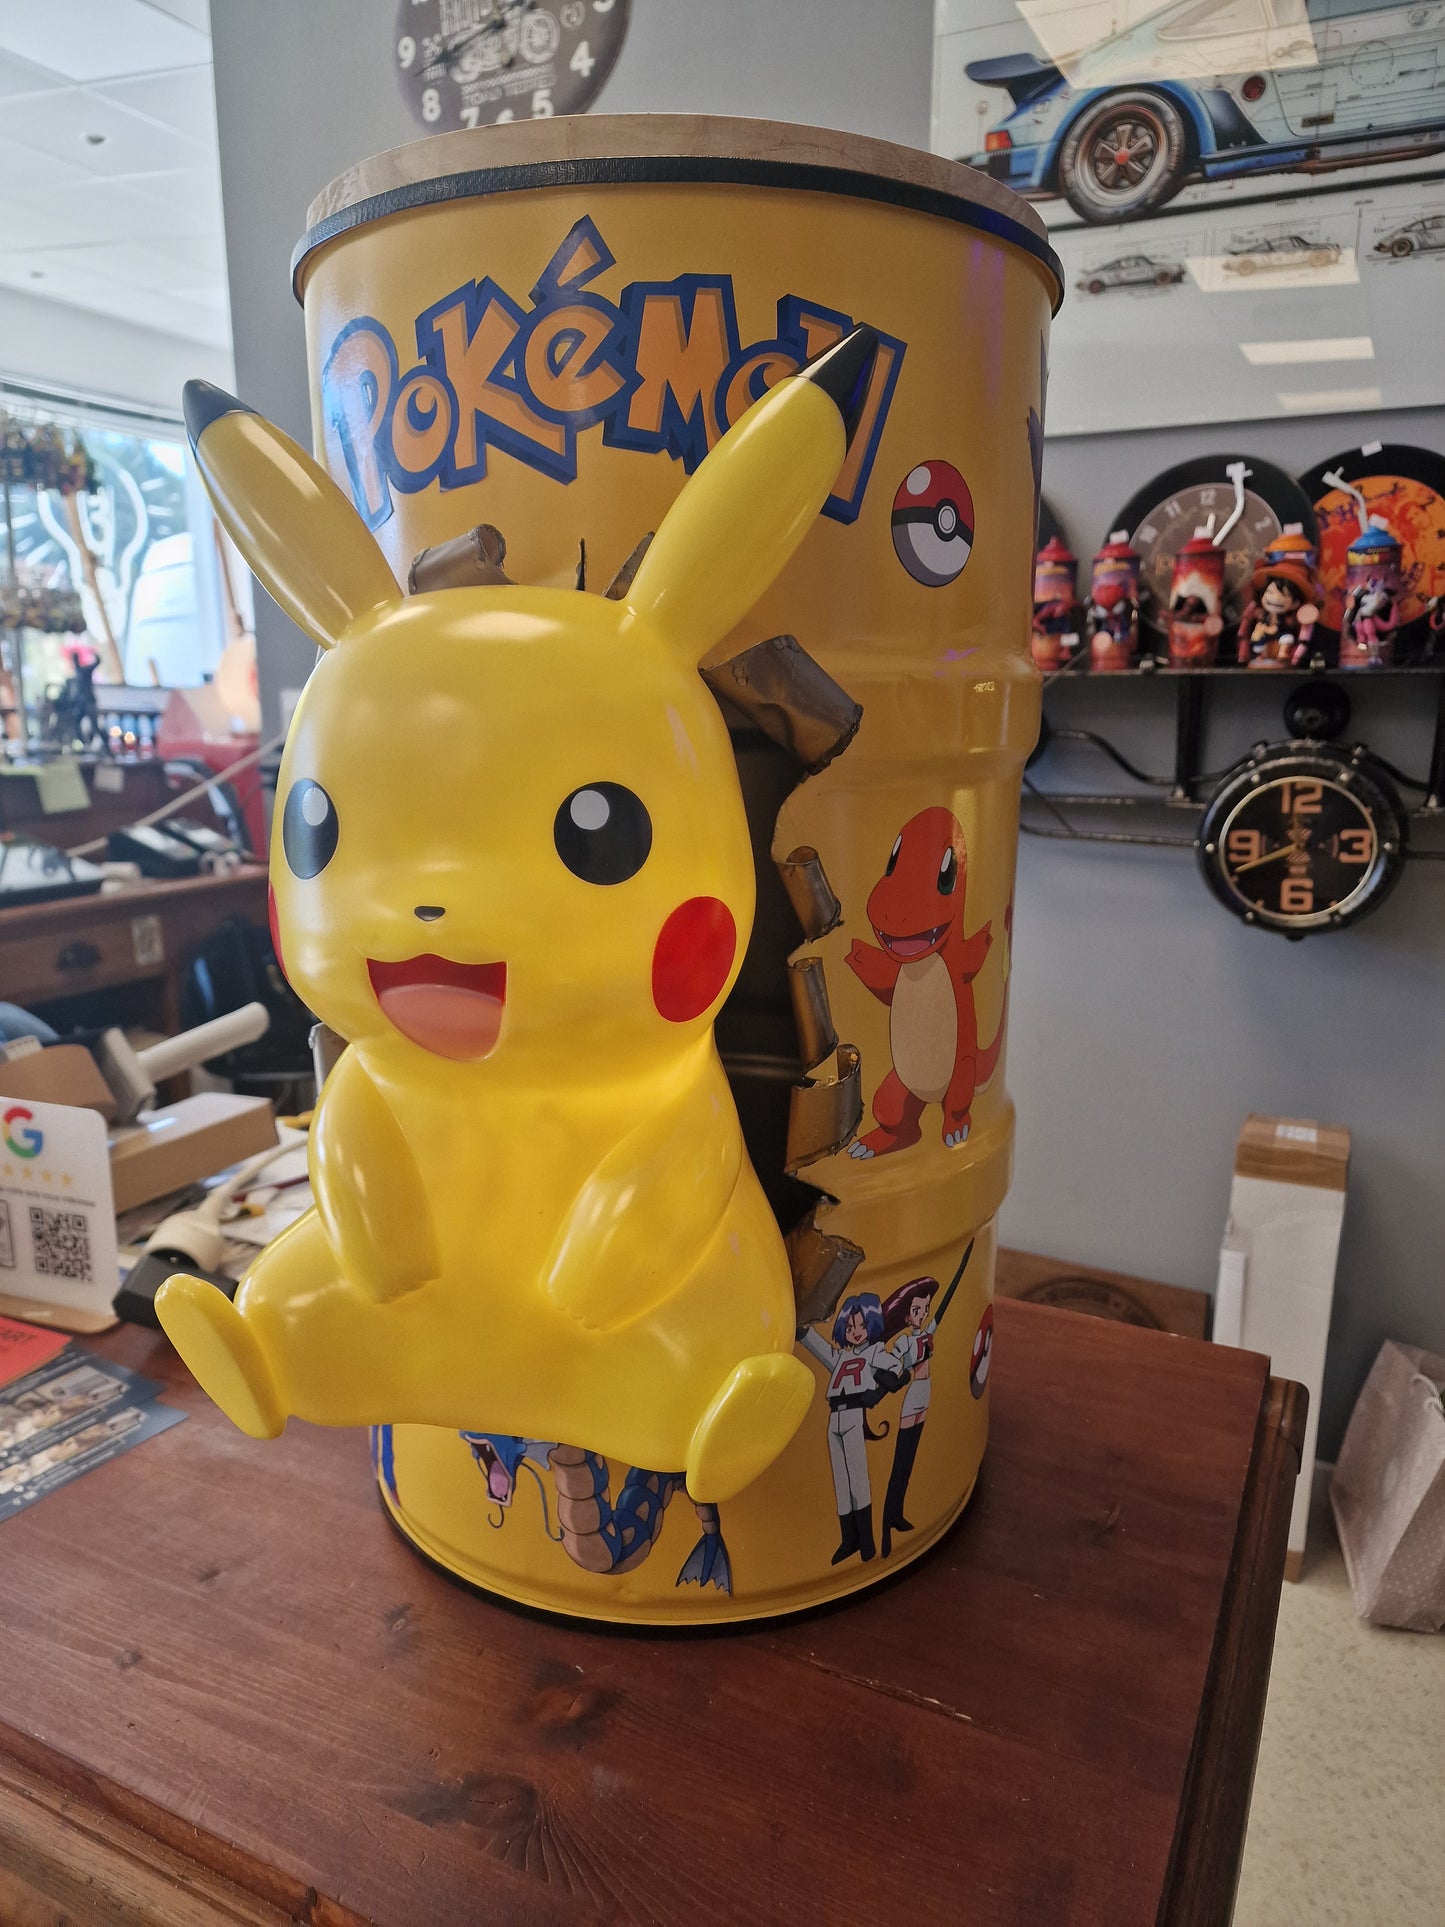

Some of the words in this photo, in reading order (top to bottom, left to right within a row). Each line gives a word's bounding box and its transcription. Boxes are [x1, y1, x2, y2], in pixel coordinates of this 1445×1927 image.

[398, 36, 416, 69] 9
[569, 41, 596, 77] 4
[421, 88, 441, 122] 8
[532, 89, 554, 119] 5
[1281, 783, 1323, 814] 12
[1228, 829, 1261, 864] 9
[1338, 828, 1372, 863] 3
[1280, 878, 1313, 912] 6
[3, 1106, 43, 1159] G
[917, 1333, 934, 1359] R
[832, 1357, 866, 1389] R
